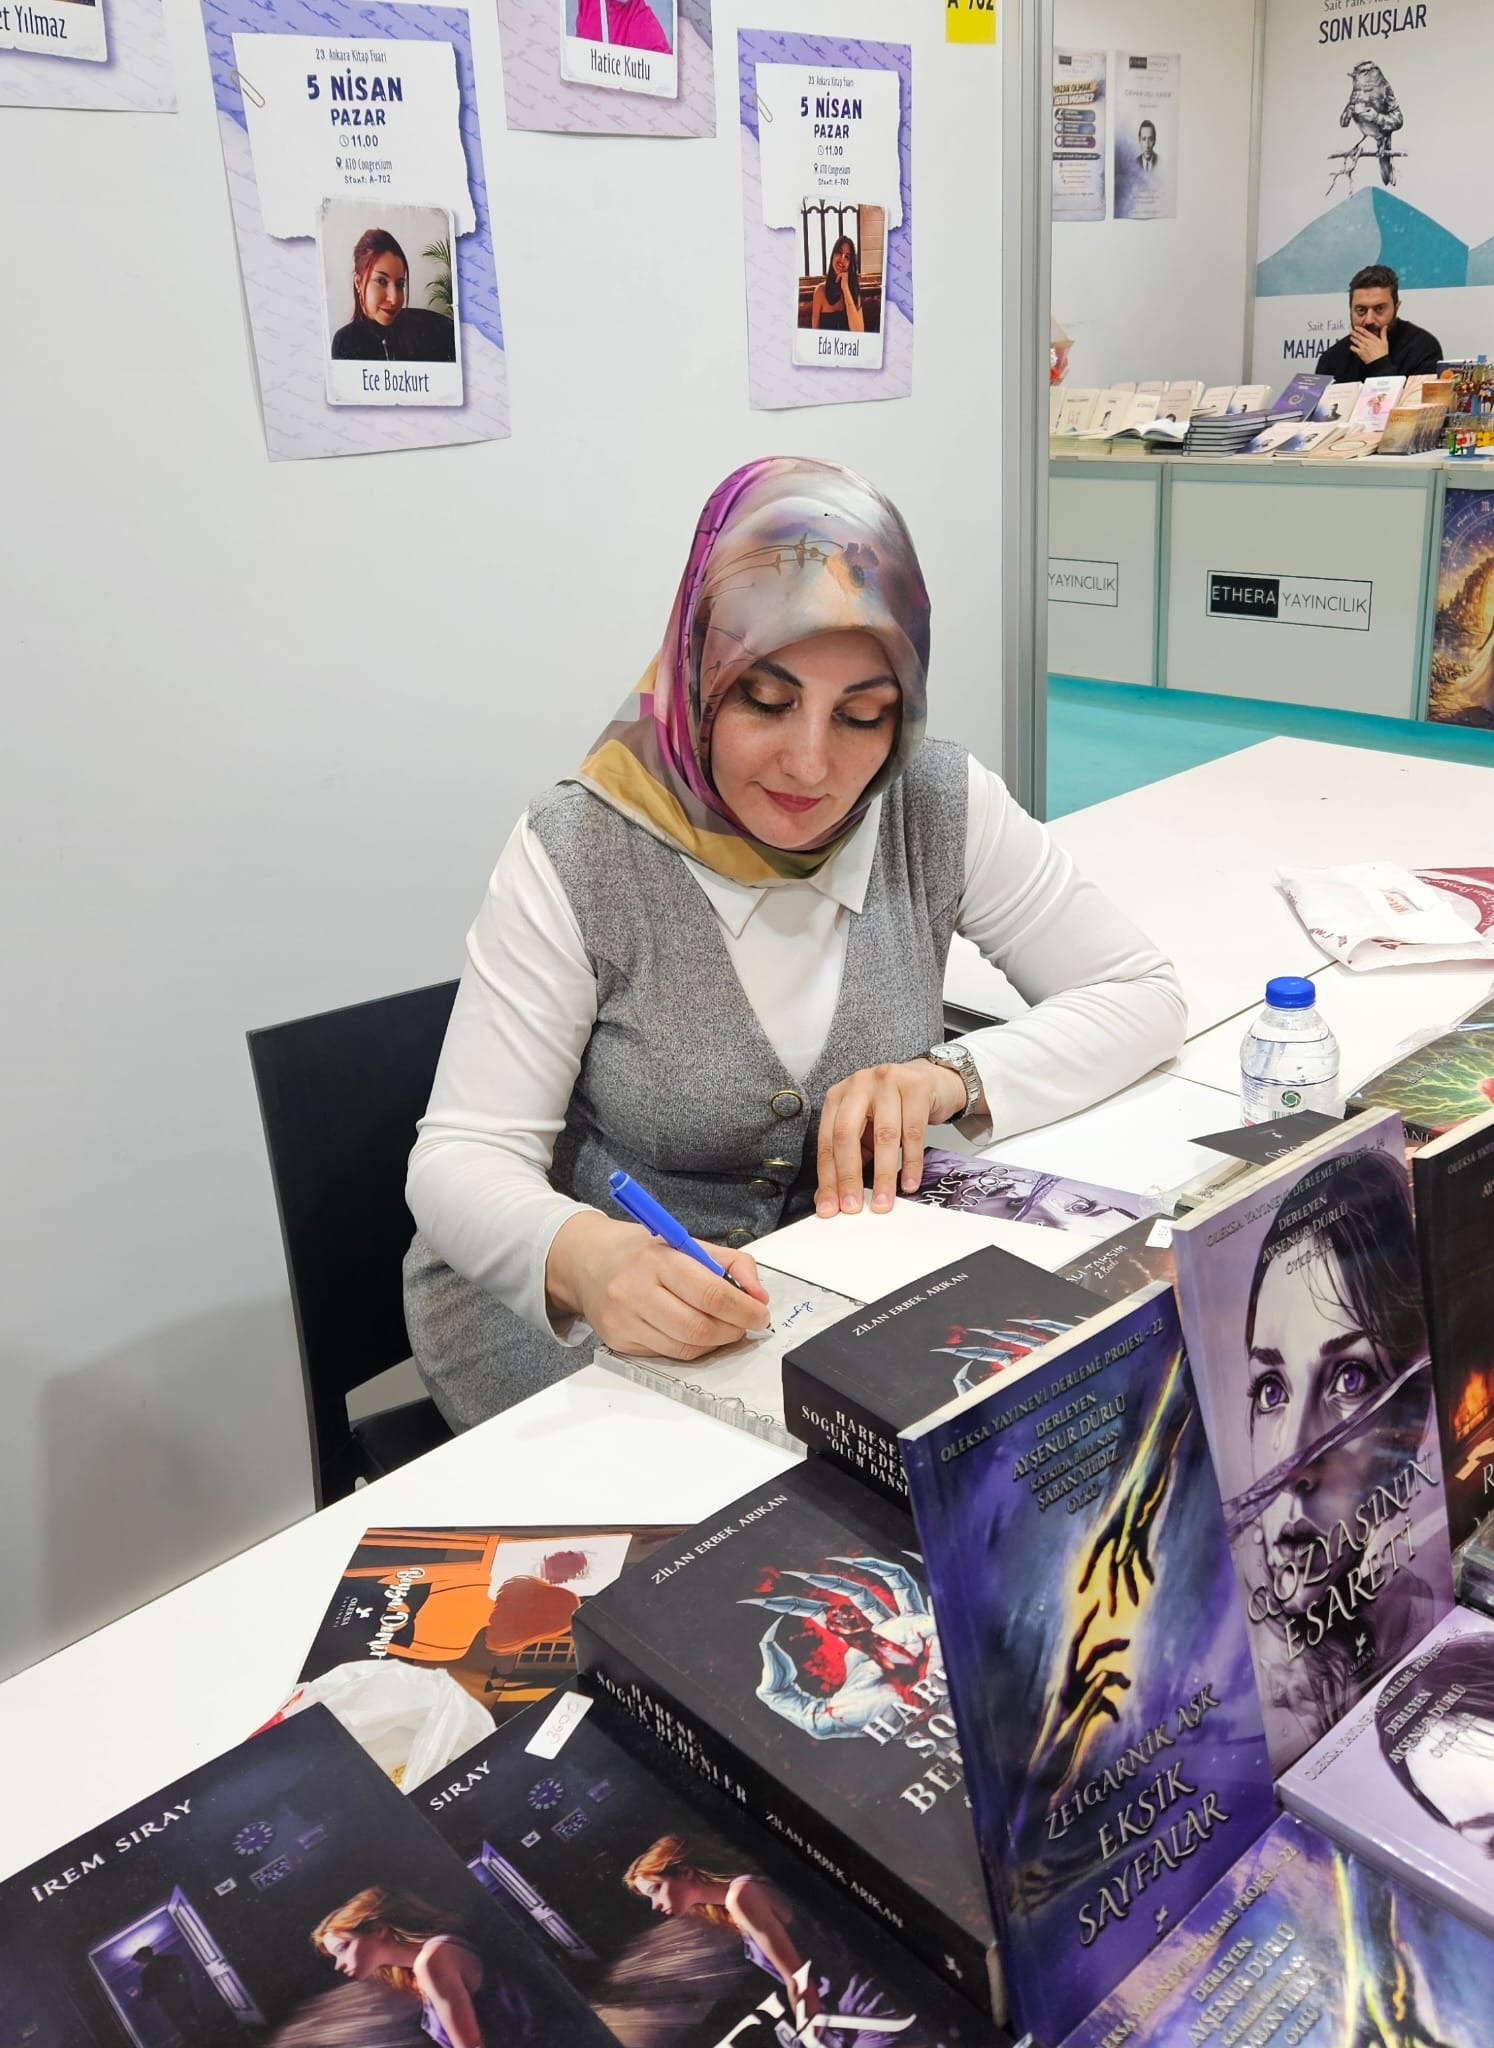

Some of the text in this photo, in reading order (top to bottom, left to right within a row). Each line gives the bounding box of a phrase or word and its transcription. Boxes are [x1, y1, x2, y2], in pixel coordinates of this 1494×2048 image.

[14, 5, 68, 39] Yılmaz
[1318, 4, 1427, 44] SON KUŞLAR
[328, 49, 351, 62] Ankara
[351, 49, 369, 64] Kitap
[590, 48, 650, 81] Hatice Kutlu
[306, 67, 403, 102] 5 NİSAN
[800, 91, 862, 119] 5 NİSAN
[330, 108, 386, 126] PAZAR
[814, 123, 850, 139] PAZAR
[345, 158, 357, 171] ATO
[369, 174, 392, 184] A-702
[818, 336, 859, 357] Eda Karaal
[362, 368, 430, 393] Ece Bozkurt
[1048, 572, 1115, 591] YAYINCILIK
[1211, 585, 1368, 613] ETHERA YAYINCILIK
[1207, 1220, 1243, 1247] OLEKSA
[1293, 1163, 1335, 1197] DERLEME
[1278, 1192, 1329, 1232] DERLEYEN
[1262, 1200, 1349, 1264] AYŞENUR DÜRLÜ
[852, 1272, 969, 1337] ZİLAN ERBEK ARIKAN
[940, 1425, 991, 1463] OLEKSA
[991, 1389, 1049, 1433] YAYINEVİ
[1050, 1356, 1104, 1398] DERLEME
[1104, 1331, 1144, 1367] PROJESİ
[1152, 1318, 1164, 1336] 22
[1012, 1393, 1127, 1483] AYŞENUR DÜRLÜ
[1035, 1391, 1098, 1439] DERLEYEN
[1037, 1446, 1121, 1513] ŞABAN YILDIZ
[651, 1494, 789, 1585] ZİLAN ERBEK ARIKAN
[1284, 1517, 1418, 1662] ESARETİ
[1378, 1669, 1419, 1708] DERLEME
[1384, 1688, 1434, 1736] DERLEYEN
[1388, 1682, 1468, 1765] AYŞENUR DÜRLÜ
[430, 1760, 491, 1811] SIRAY
[1098, 1760, 1197, 1862] EKSİK
[31, 1798, 192, 1904] İREM SIRAY
[1077, 1792, 1231, 1947] SAYFALAR
[850, 1880, 904, 1929] ARIKAN
[1191, 1908, 1241, 1962] DERLEME
[1279, 1845, 1299, 1864] 22
[1188, 1922, 1297, 2047] AYŞENUR DÜRLÜ
[1192, 1935, 1255, 2003] DERLEYEN
